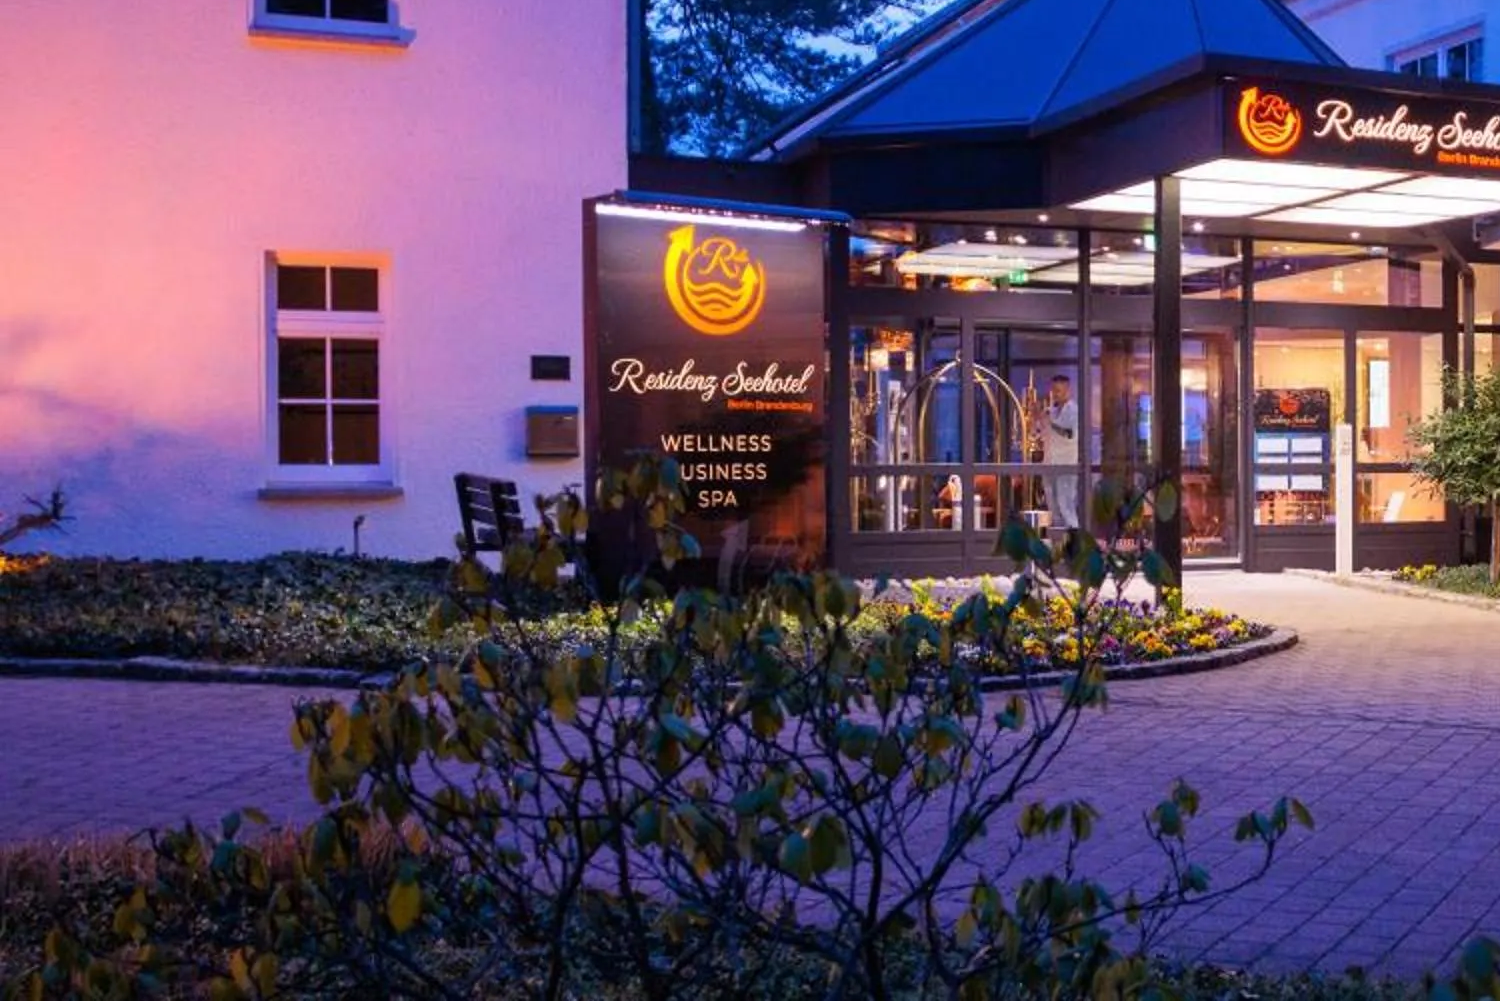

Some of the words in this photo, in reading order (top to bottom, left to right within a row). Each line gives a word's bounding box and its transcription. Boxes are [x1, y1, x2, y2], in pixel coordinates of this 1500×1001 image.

[1313, 100, 1435, 154] Residenz
[609, 358, 718, 401] Residenz
[721, 361, 815, 395] Seehotel
[660, 433, 772, 453] WELLNESS
[680, 462, 768, 481] USINESS
[697, 489, 738, 509] SPA
